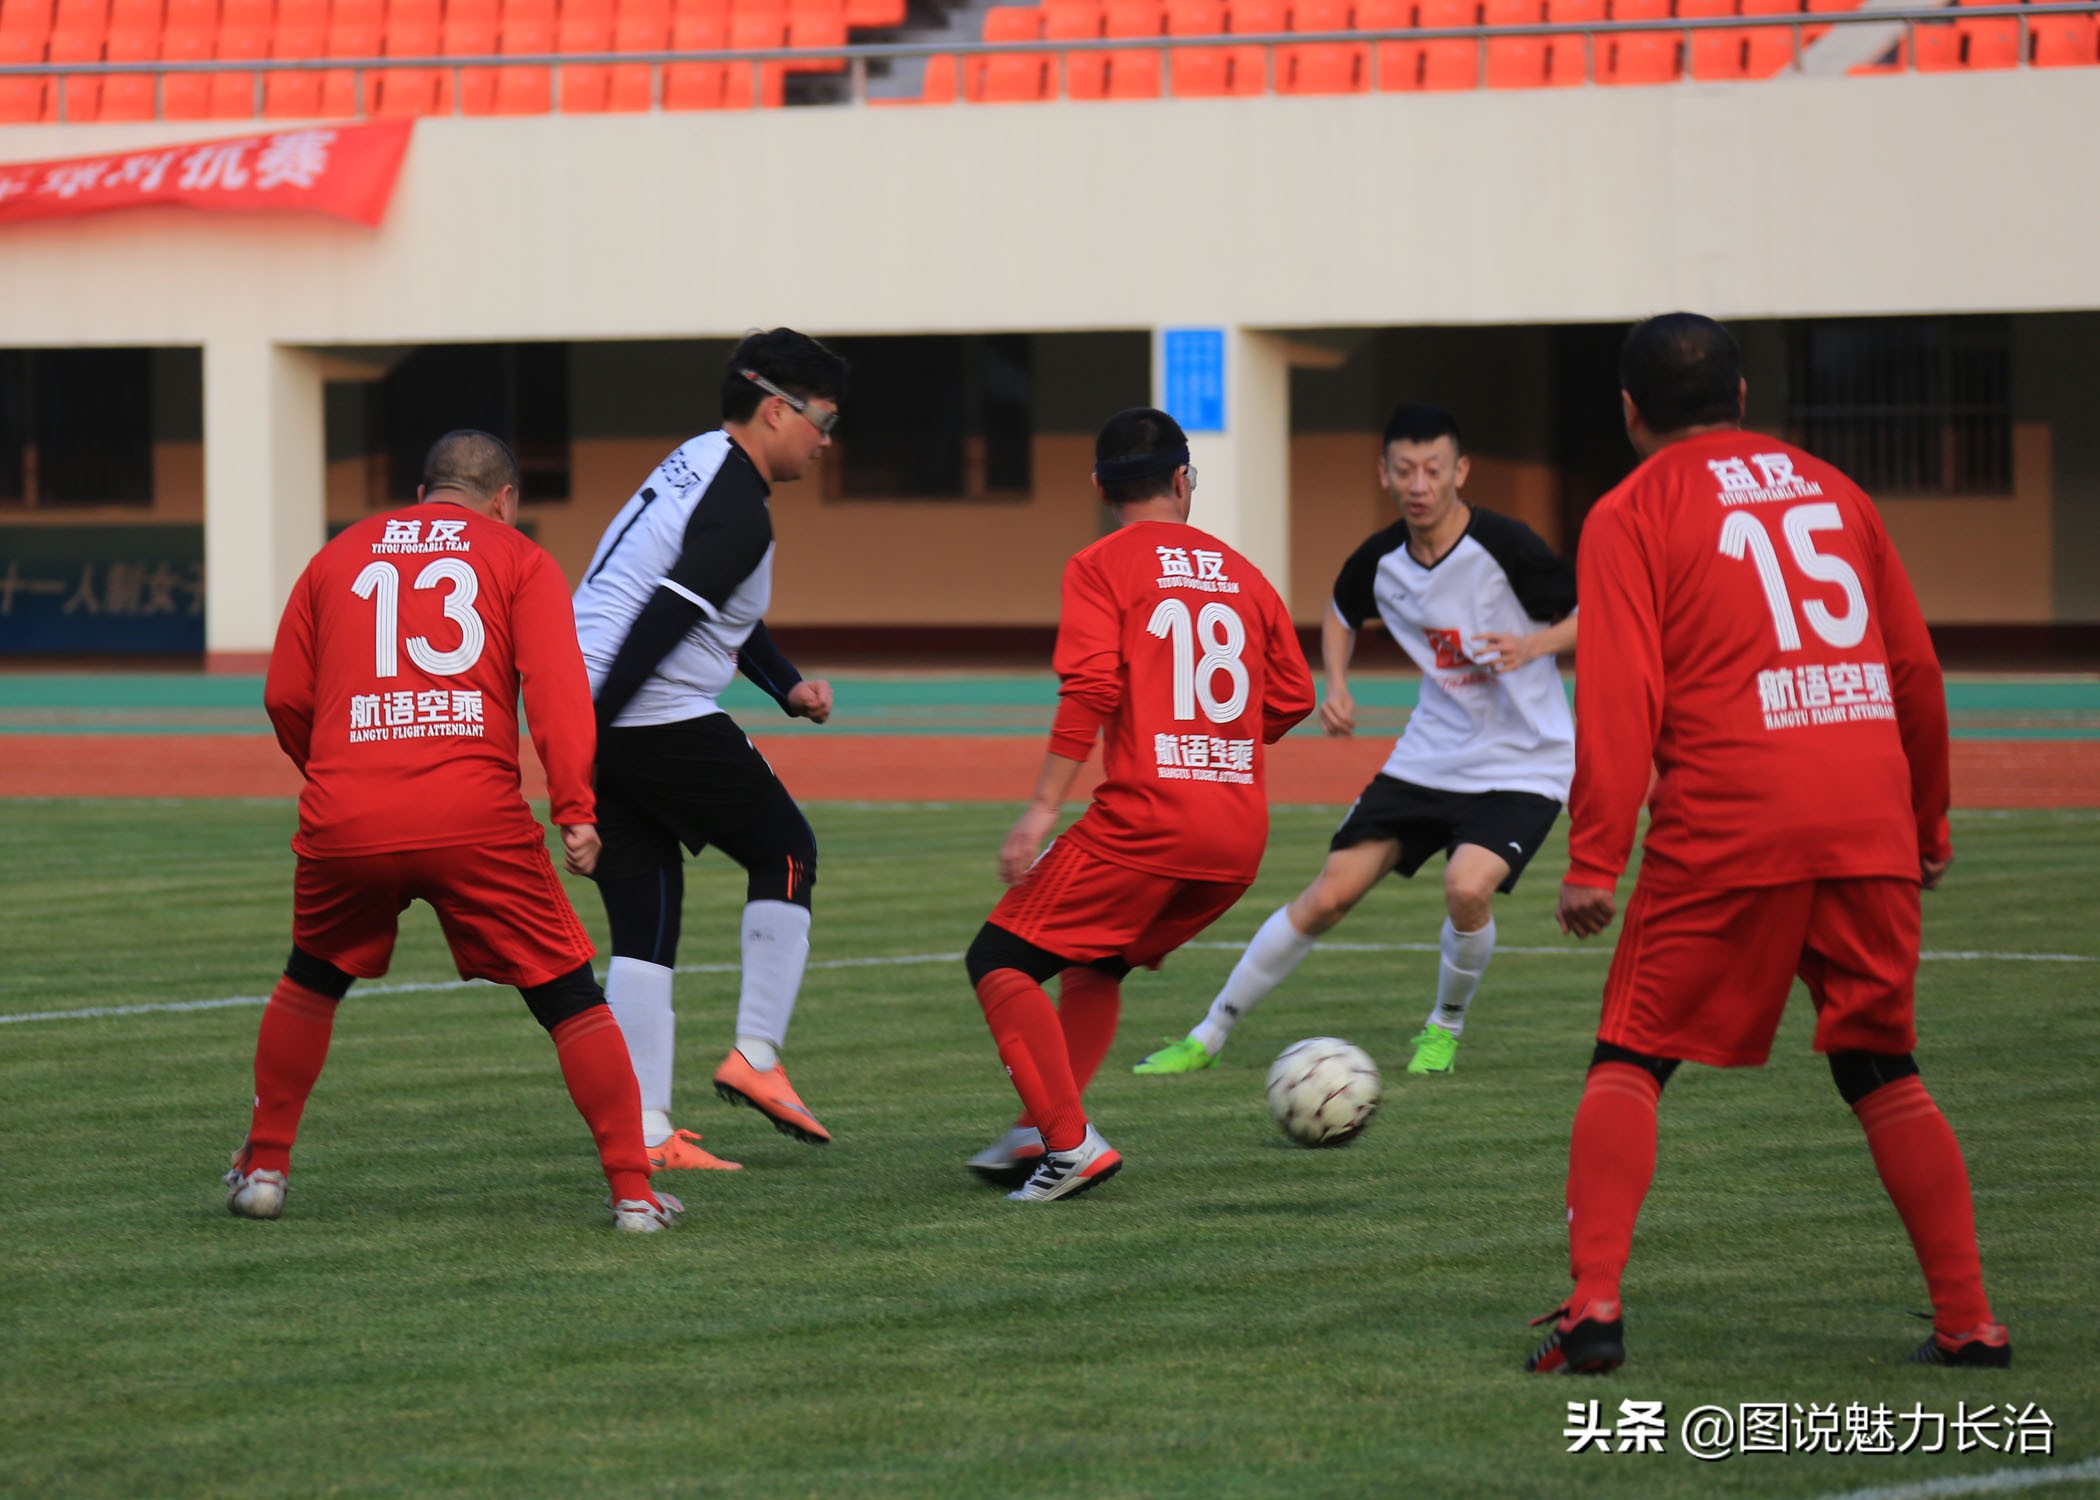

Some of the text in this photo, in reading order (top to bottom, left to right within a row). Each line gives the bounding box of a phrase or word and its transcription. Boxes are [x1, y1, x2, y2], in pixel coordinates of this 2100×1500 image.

[1708, 453, 1805, 491] 益友
[372, 543, 401, 554] YIYOU
[446, 541, 471, 552] TEAM
[382, 519, 468, 543] 益友
[1156, 545, 1229, 581] 益友
[1718, 502, 1869, 651] 15
[351, 557, 485, 678] 13
[1146, 598, 1250, 724] 18
[1757, 662, 1893, 712] 航语空乘
[350, 689, 484, 729] 航语空乘
[350, 723, 485, 743] HANGYU FLIGHT ATTENDANT
[1154, 733, 1255, 772] 航语空乘
